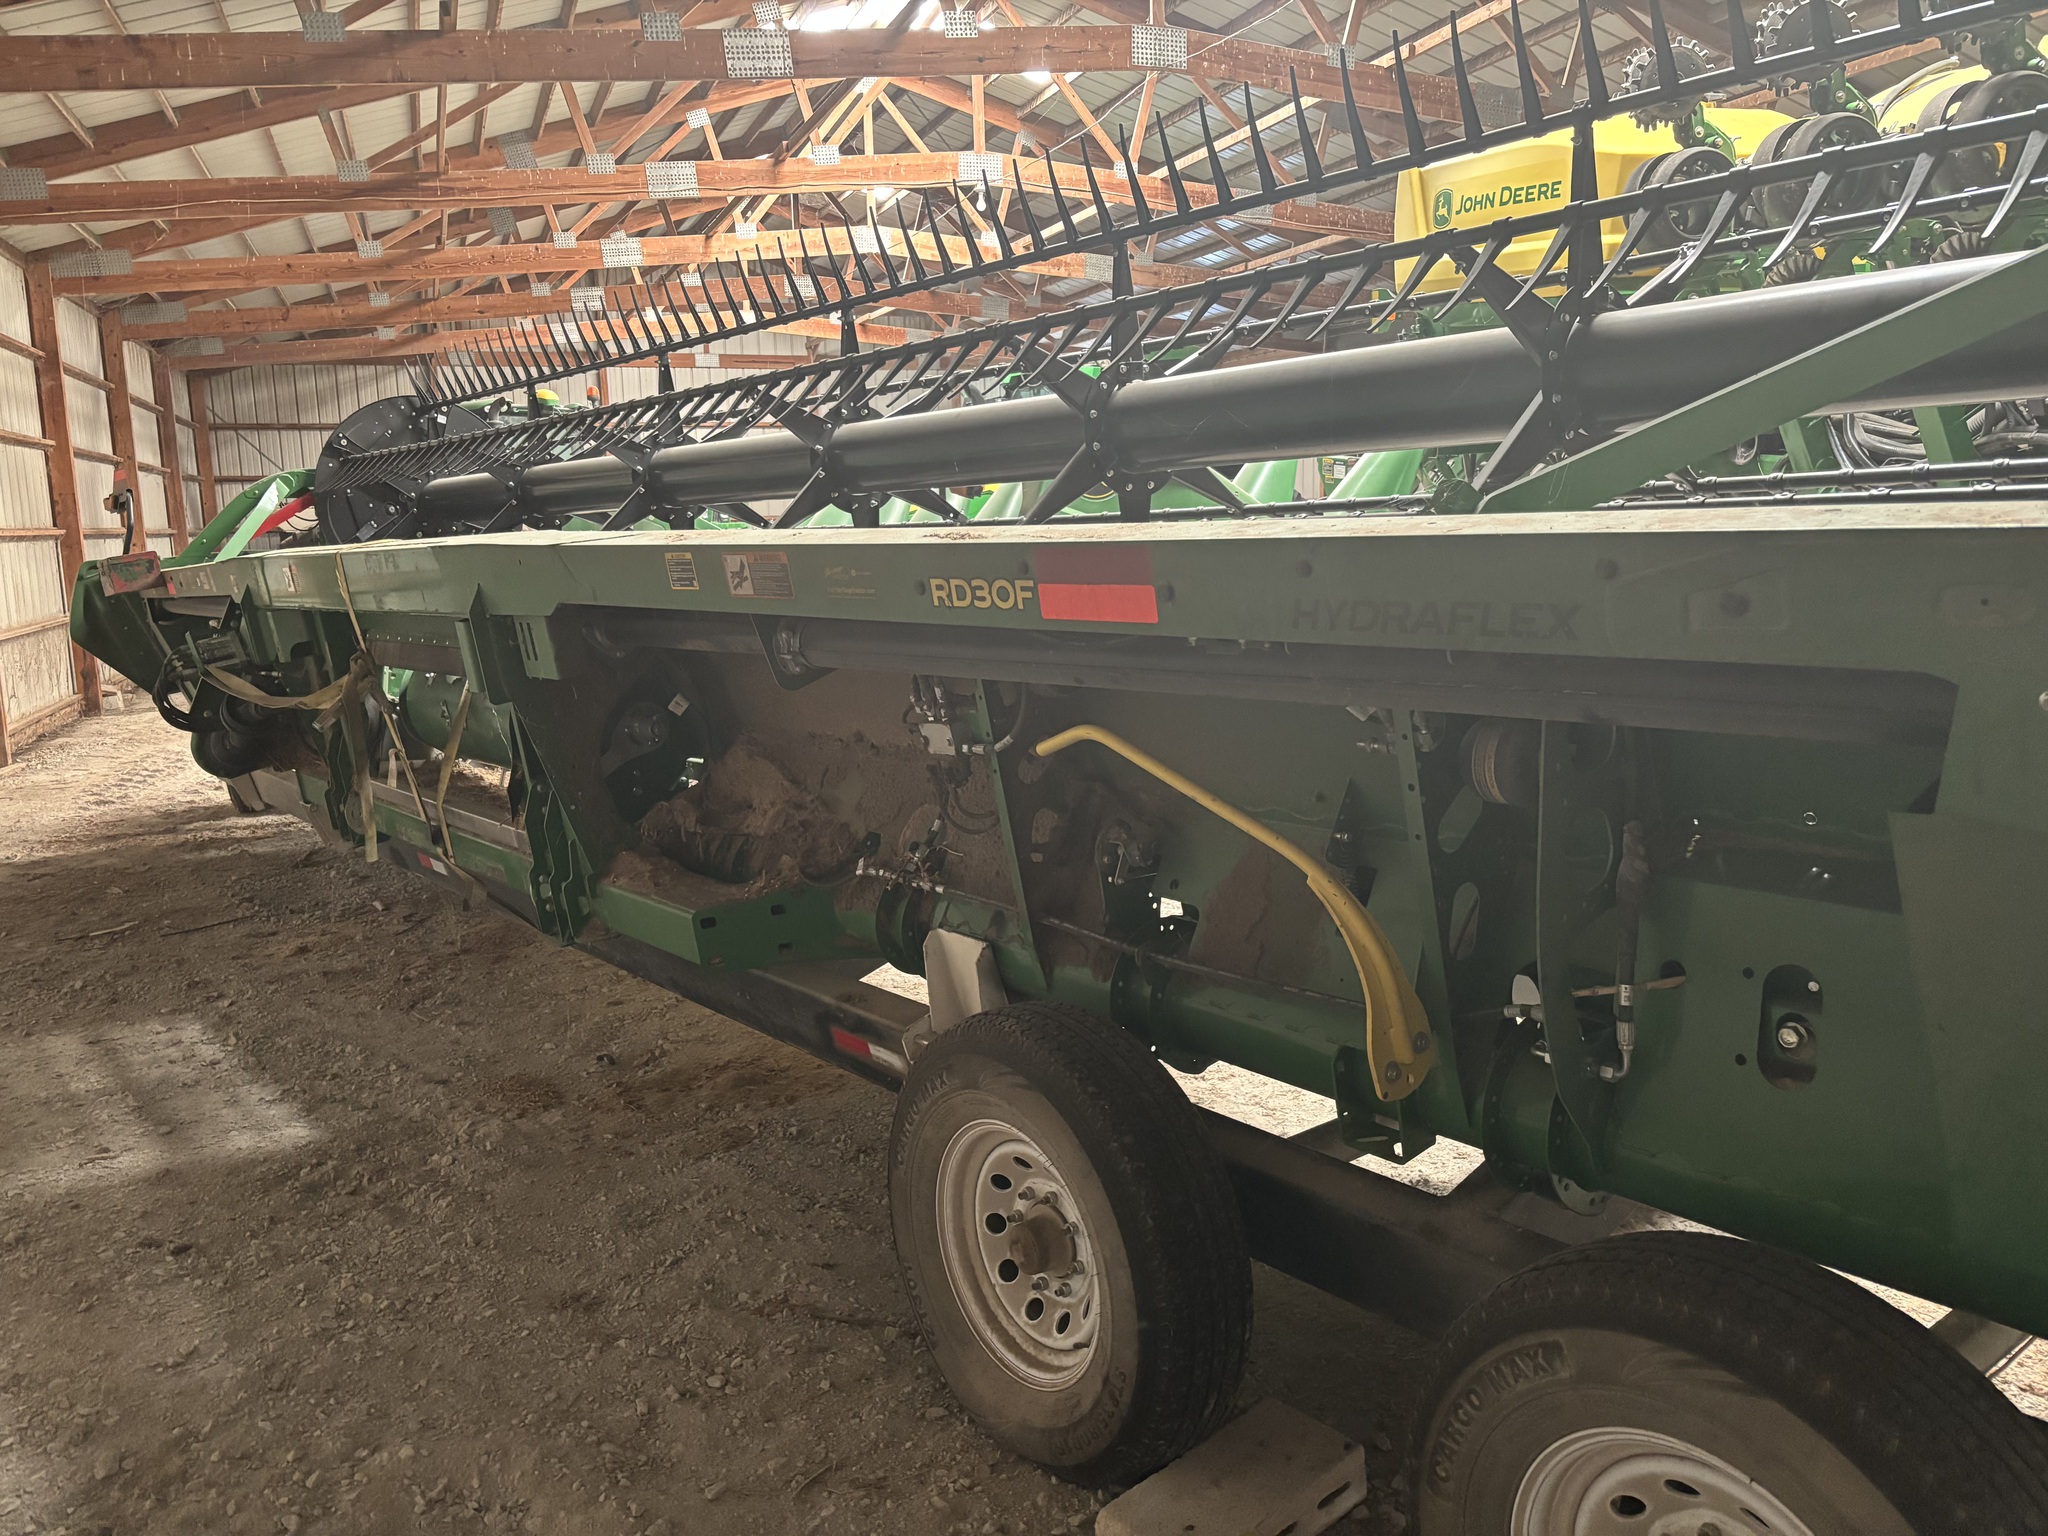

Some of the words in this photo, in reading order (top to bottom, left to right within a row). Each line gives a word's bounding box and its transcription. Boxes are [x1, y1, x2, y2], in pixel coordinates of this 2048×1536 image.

[1455, 192, 1496, 216] JOHN
[1499, 180, 1563, 207] DEERE
[928, 577, 1035, 611] RD30F
[1291, 598, 1584, 641] HYDRAFLEX
[919, 1069, 950, 1104] MAX
[1433, 1386, 1485, 1484] CARGO
[1484, 1347, 1554, 1395] MAX
